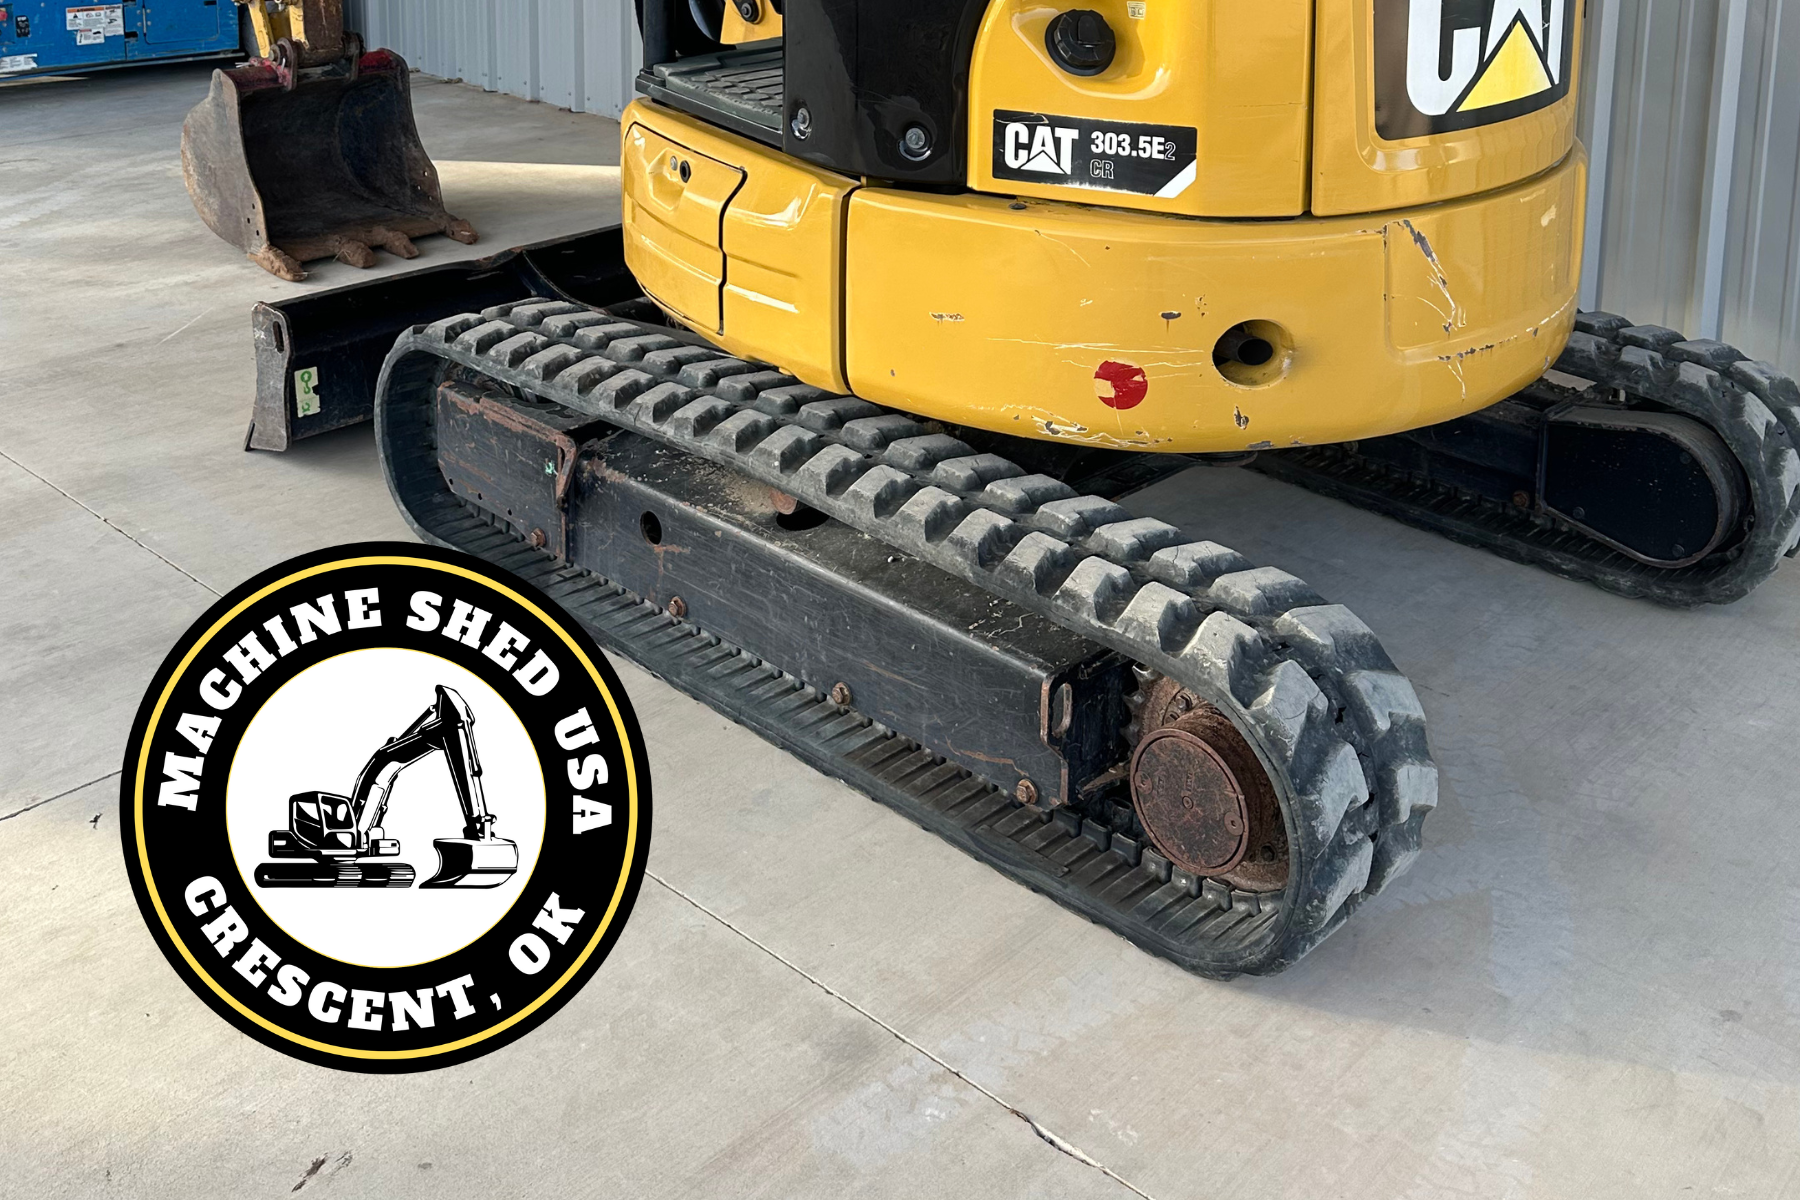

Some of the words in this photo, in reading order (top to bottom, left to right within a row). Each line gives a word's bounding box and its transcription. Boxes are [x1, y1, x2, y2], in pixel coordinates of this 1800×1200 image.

[1004, 122, 1079, 175] CAT
[1090, 131, 1176, 161] 303.5E2
[1090, 159, 1114, 179] CR
